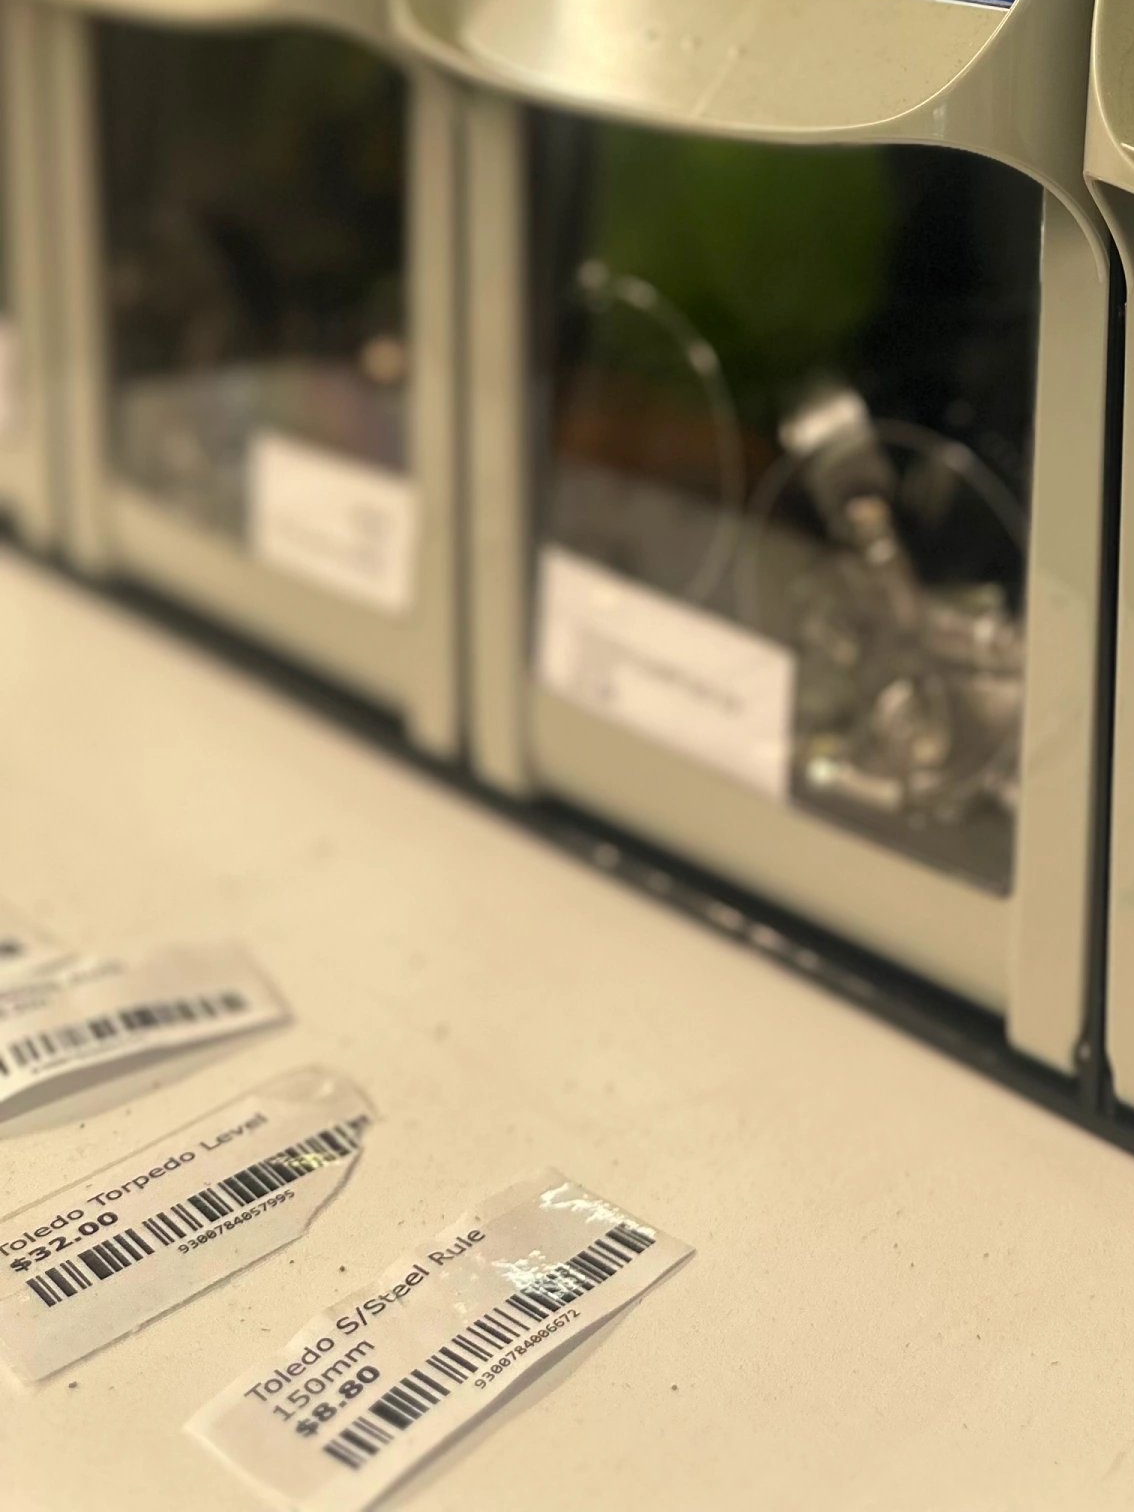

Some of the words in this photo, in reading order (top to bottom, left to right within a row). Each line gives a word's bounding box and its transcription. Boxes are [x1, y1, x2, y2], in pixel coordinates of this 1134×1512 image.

[0, 1209, 84, 1256] Toledo
[87, 1149, 196, 1206] Torpedo
[199, 1113, 269, 1152] Level
[178, 1189, 296, 1254] 9300784057995
[10, 1211, 119, 1272] $32.00
[244, 1337, 335, 1404] Toledo
[336, 1264, 430, 1335] S/Steel
[428, 1227, 487, 1266] Rule
[474, 1308, 581, 1389] 9300784006672
[272, 1339, 376, 1422] 150mm
[295, 1365, 381, 1437] $8.80
